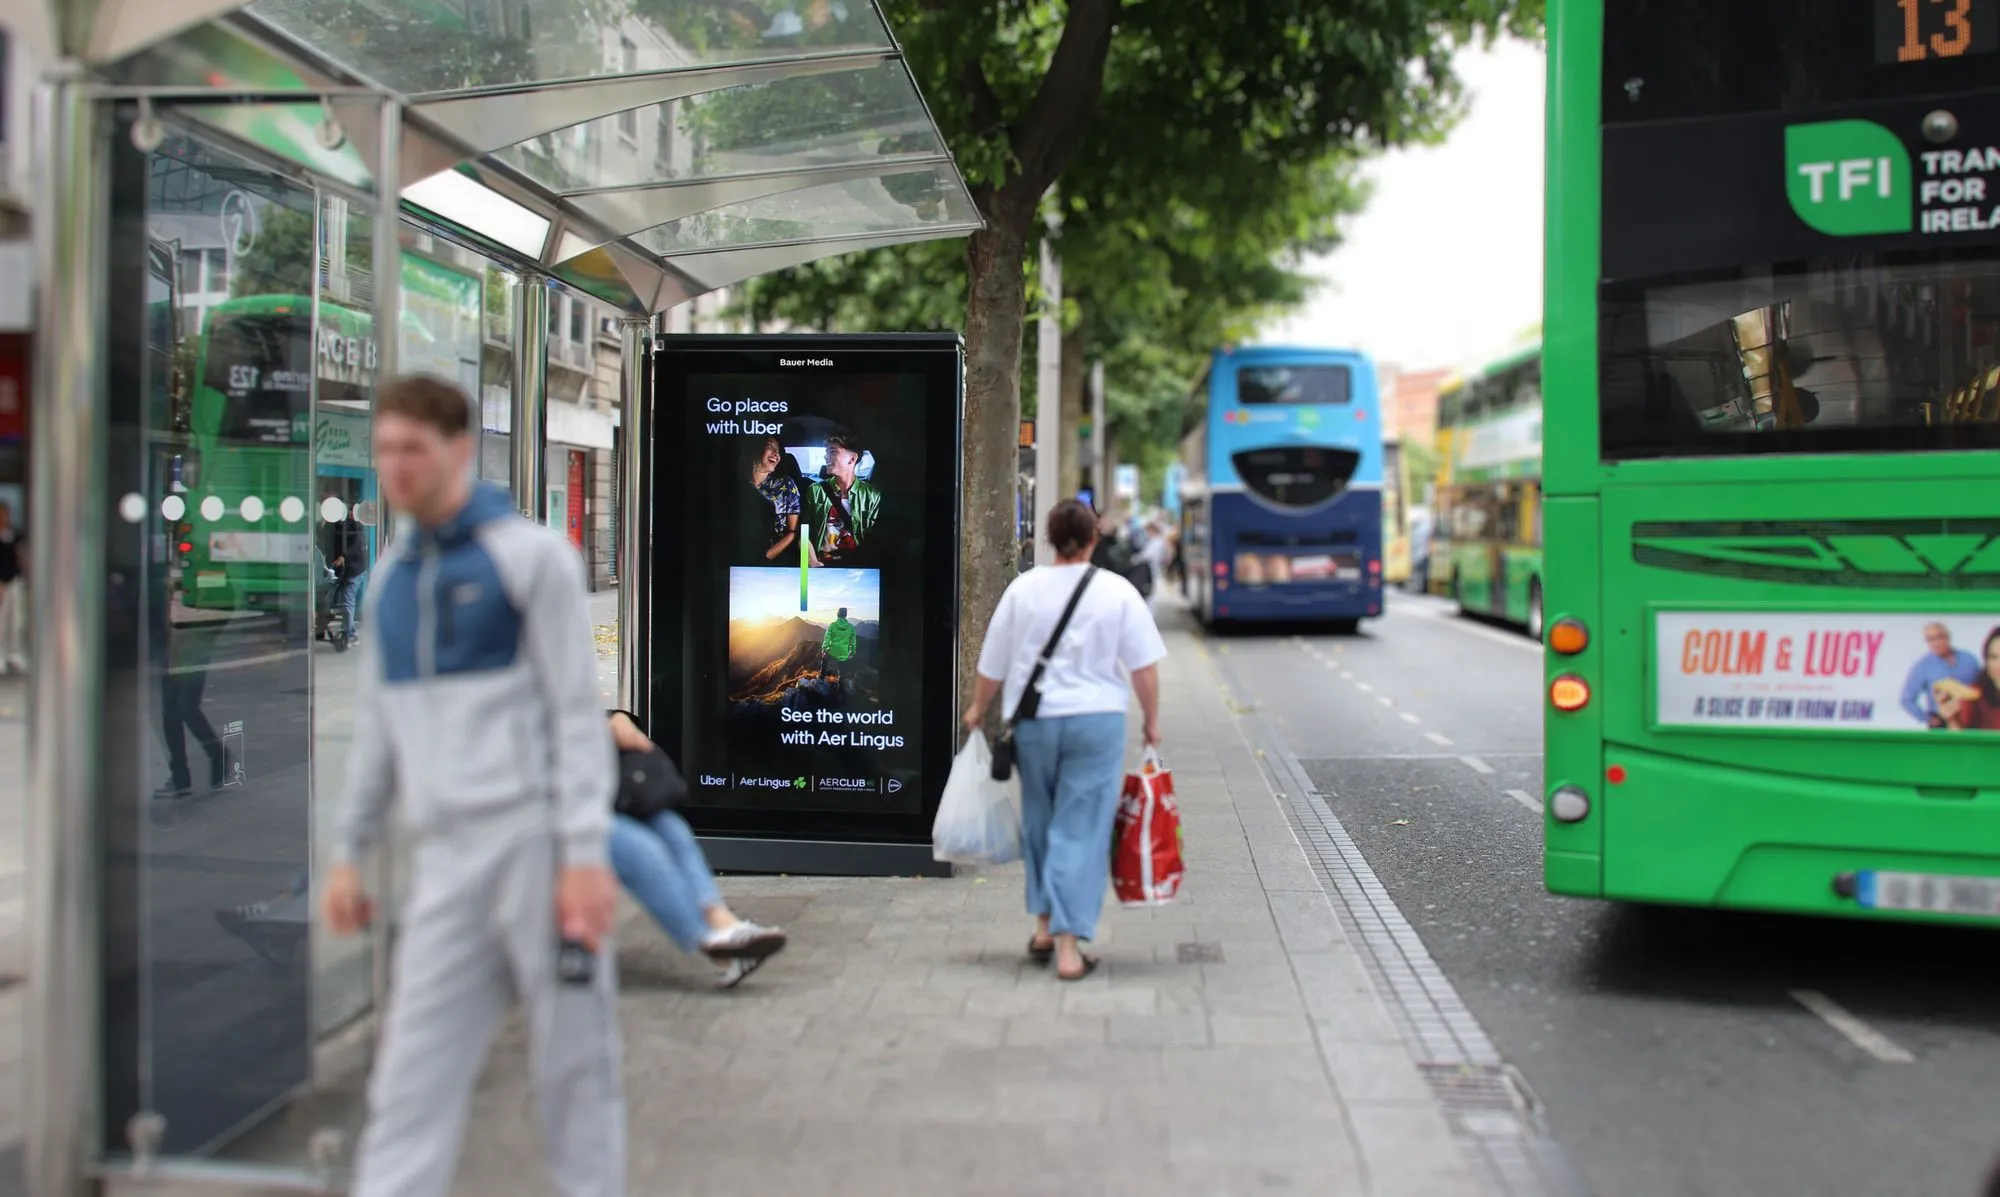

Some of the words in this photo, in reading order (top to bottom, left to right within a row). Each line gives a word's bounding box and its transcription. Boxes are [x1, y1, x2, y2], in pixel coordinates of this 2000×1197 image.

[1897, 0, 1971, 62] 13
[1798, 156, 1892, 204] TFI
[1920, 177, 1986, 205] FOR
[807, 358, 833, 366] Media
[706, 397, 732, 412] Go
[735, 397, 788, 416] places
[706, 420, 740, 434] with
[743, 420, 783, 435] Uber
[1681, 628, 1767, 676] COLM
[1774, 636, 1794, 672] &
[1803, 630, 1884, 678] LUCY
[781, 707, 813, 723] See
[816, 708, 843, 723] the
[846, 710, 893, 725] world
[1707, 697, 1743, 718] SLICE
[1746, 698, 1764, 718] OF
[1765, 698, 1793, 718] FUN
[1796, 699, 1836, 719] FROM
[781, 730, 815, 745] with
[818, 730, 847, 746] Aer
[850, 731, 904, 750] Lingus
[700, 775, 727, 786] Uber
[739, 776, 757, 786] Aer
[758, 777, 791, 789] Lingus
[819, 778, 866, 787] AERCLUB
